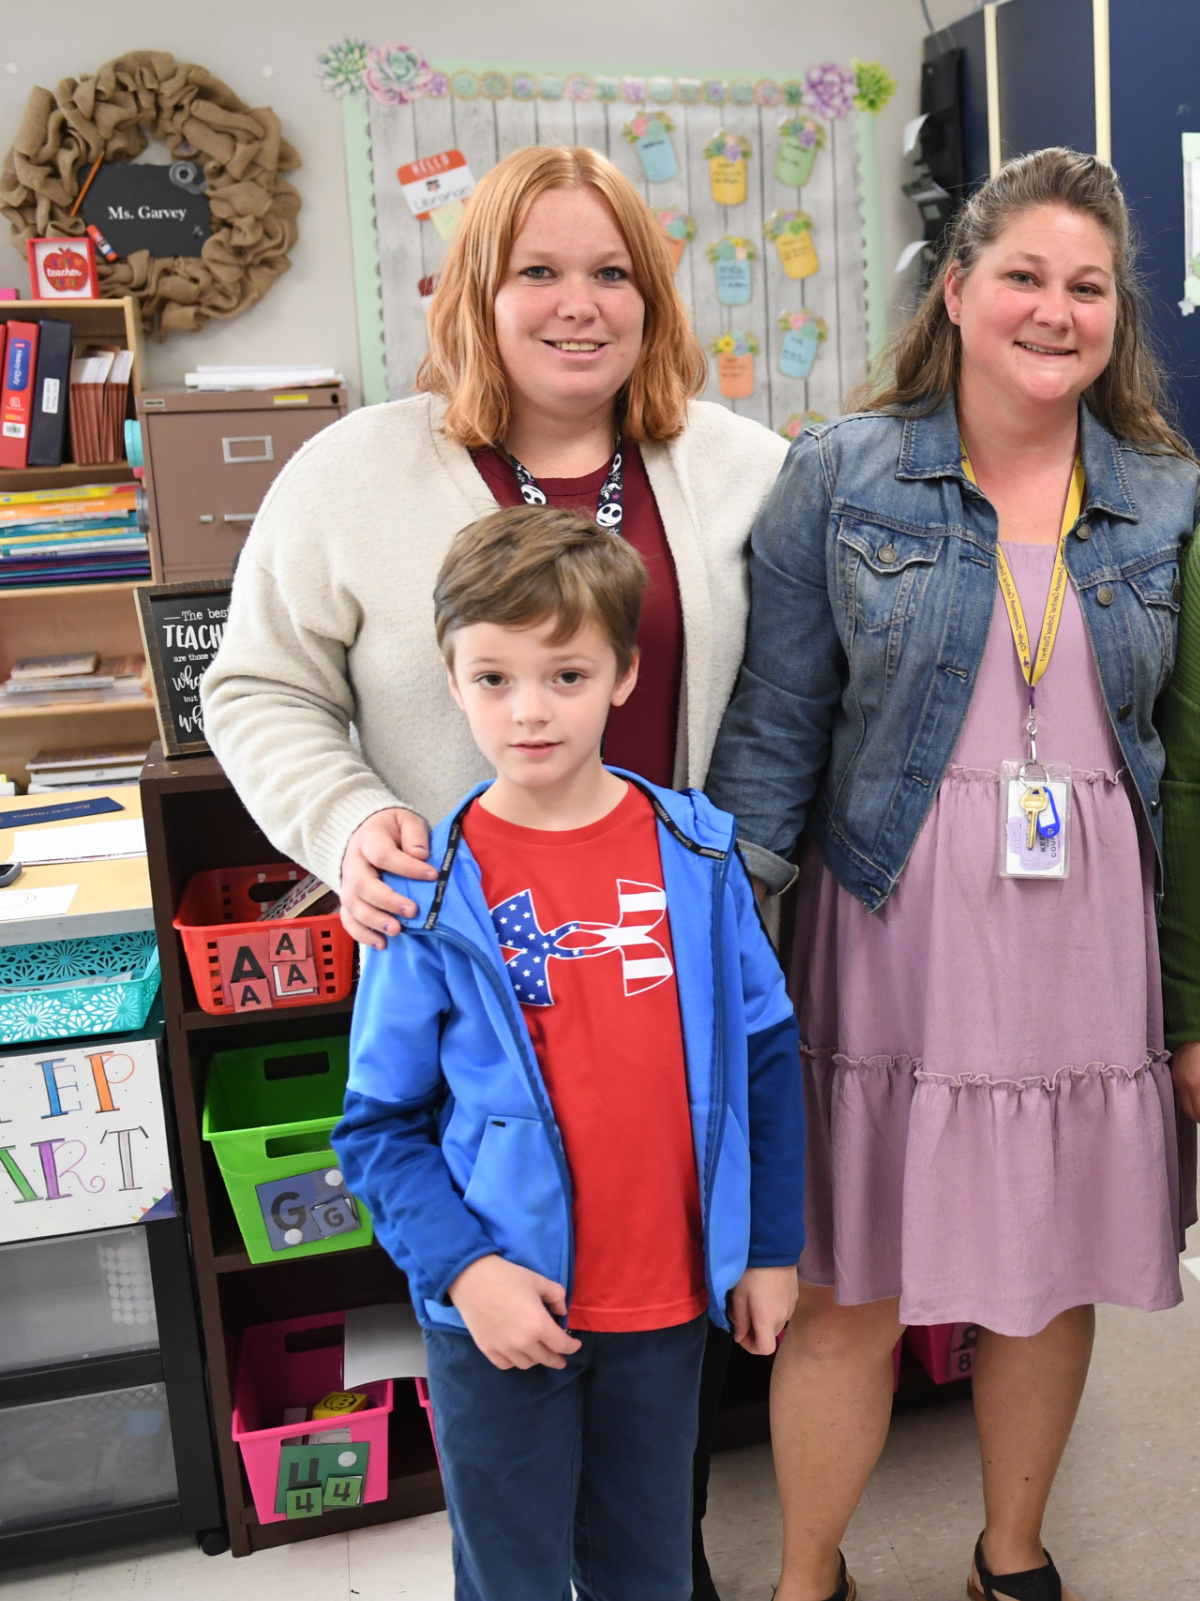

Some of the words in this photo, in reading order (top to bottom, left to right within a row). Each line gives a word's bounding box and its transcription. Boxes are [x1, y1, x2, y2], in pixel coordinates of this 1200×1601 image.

[411, 152, 450, 175] HELLO
[107, 206, 134, 220] Ms.
[137, 205, 188, 222] Garvey
[46, 267, 83, 278] teacher
[182, 610, 204, 621] The
[173, 655, 187, 663] are
[188, 652, 209, 661] those
[183, 695, 199, 703] but
[275, 932, 296, 956] A
[230, 945, 267, 983] A
[287, 964, 308, 987] A
[240, 985, 262, 1007] A
[0, 1051, 135, 1124] EP
[271, 1191, 307, 1231] G
[323, 1207, 344, 1228] G
[958, 1353, 972, 1373] 8
[333, 1481, 351, 1502] 4
[295, 1492, 314, 1513] 4
